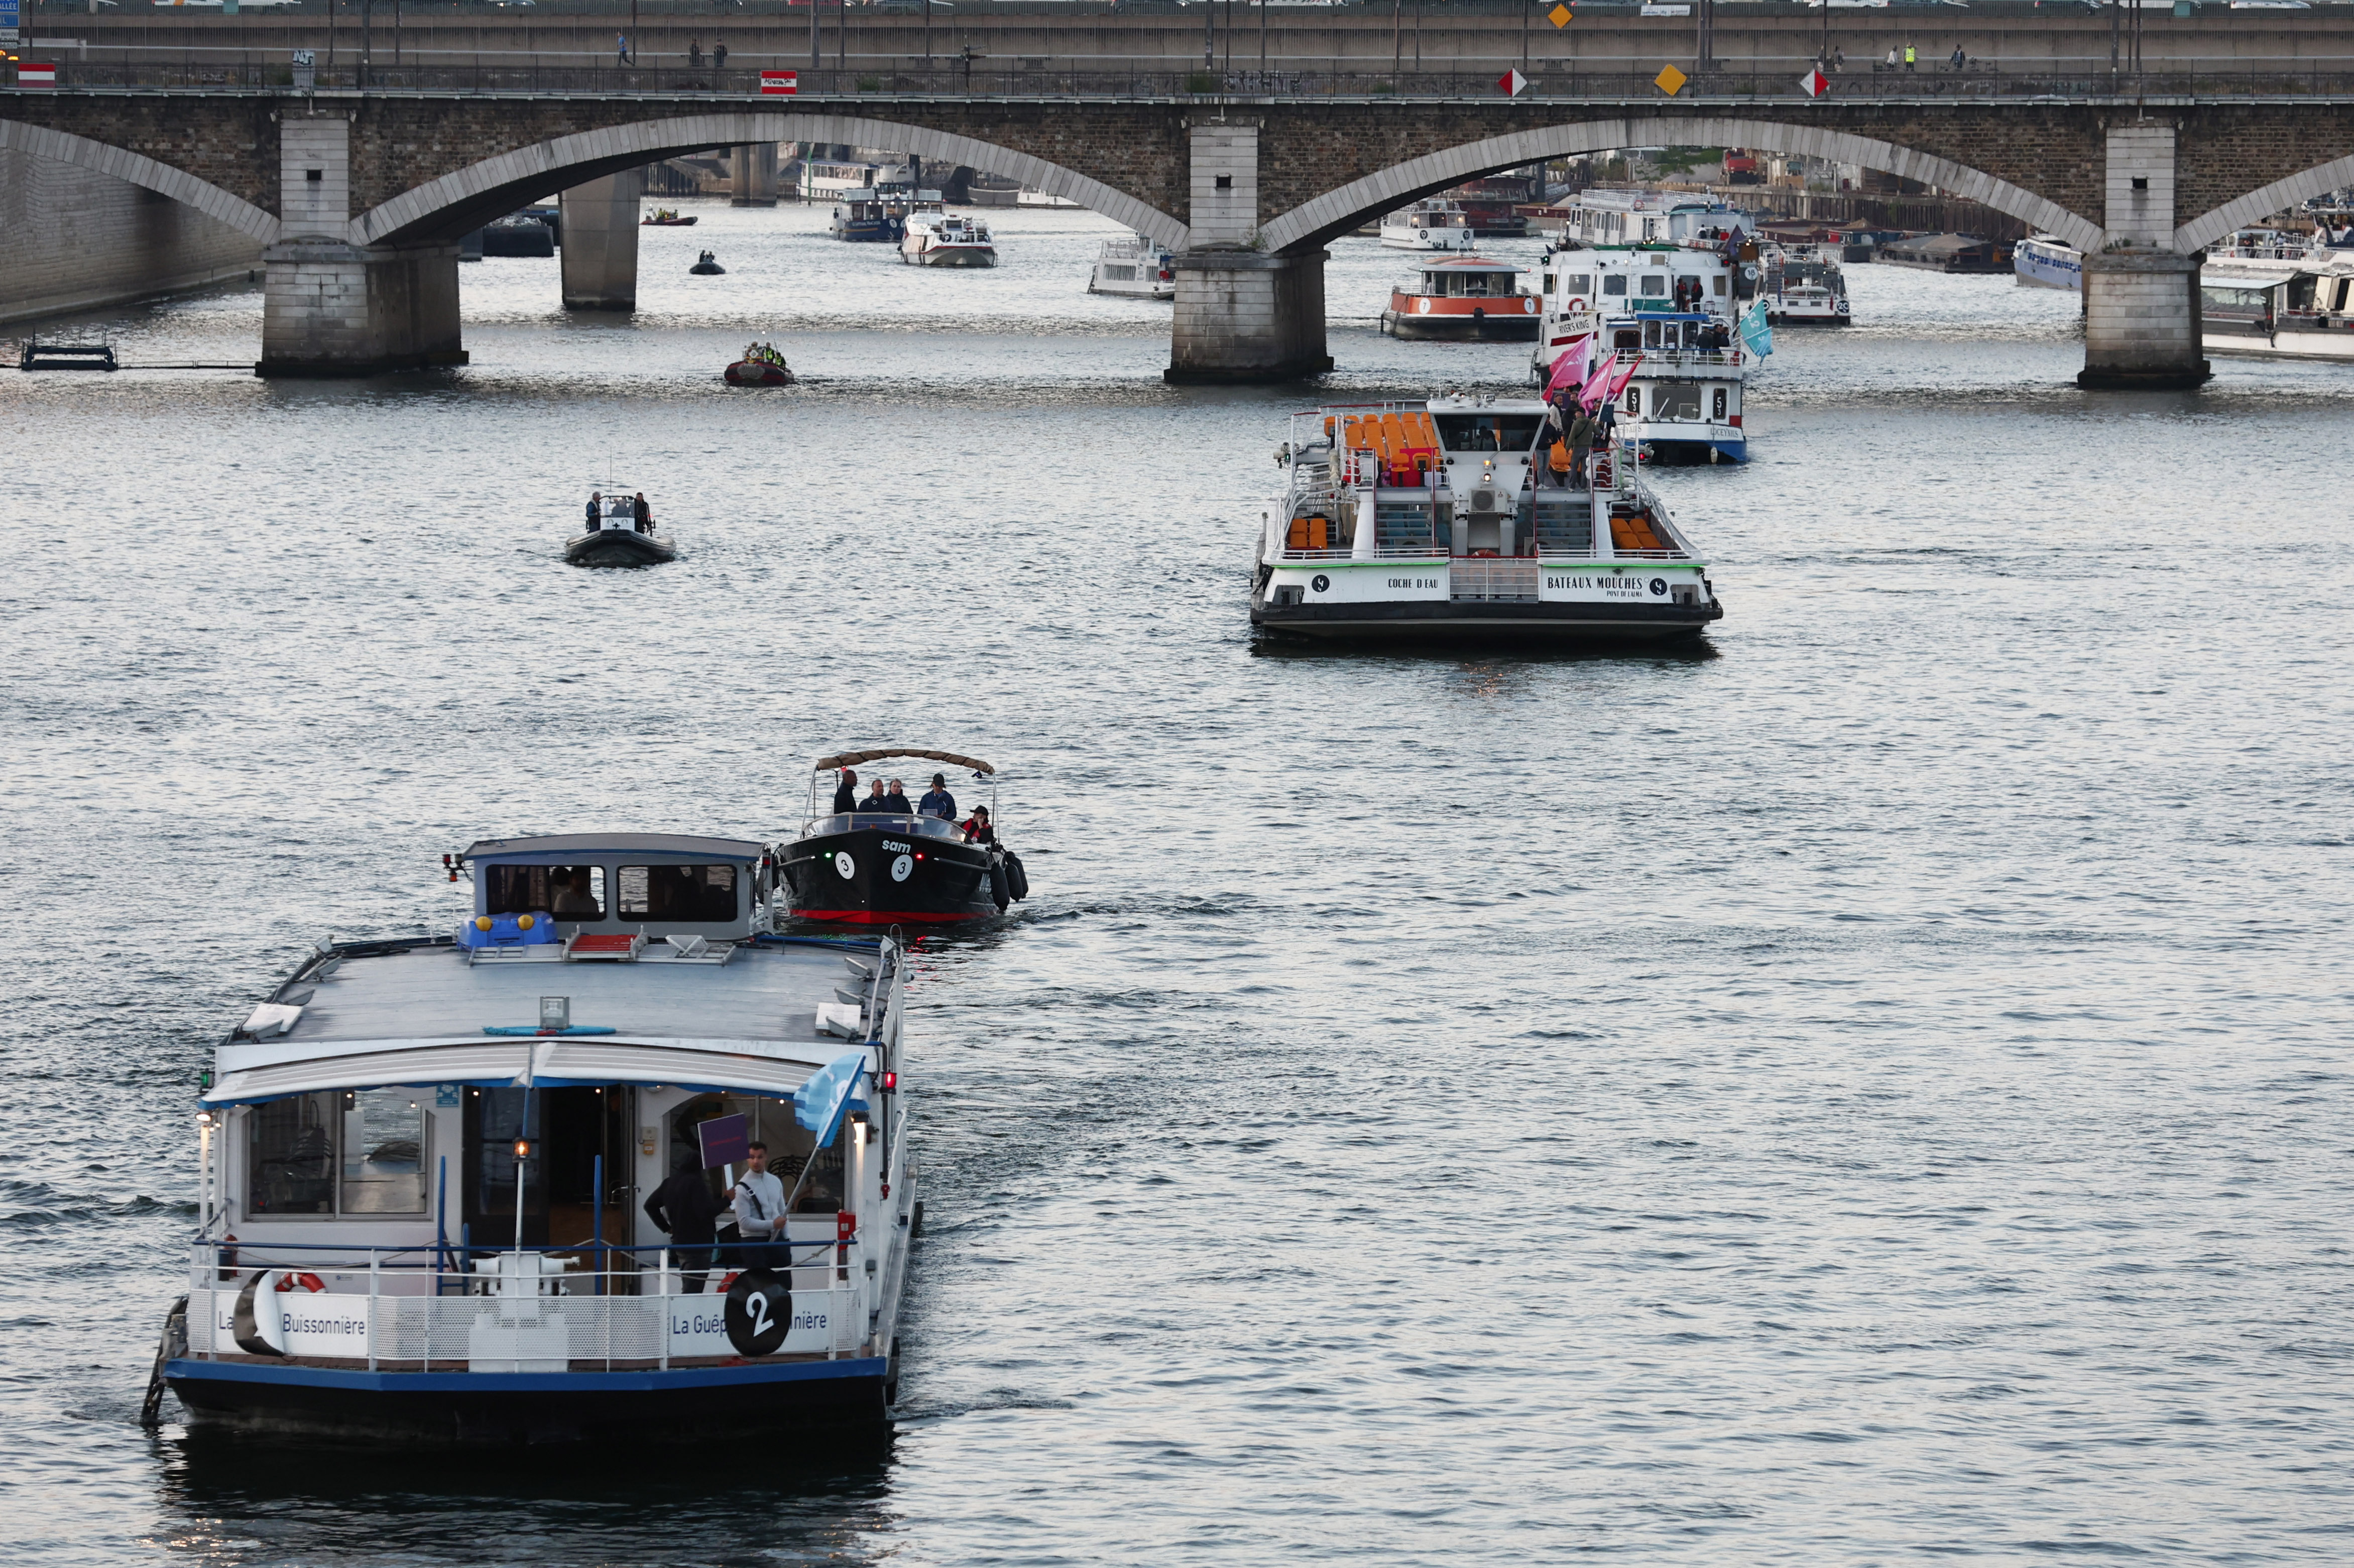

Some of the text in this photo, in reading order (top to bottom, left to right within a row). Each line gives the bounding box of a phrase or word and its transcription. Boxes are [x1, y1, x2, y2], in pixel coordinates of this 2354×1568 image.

[1559, 319, 1590, 334] RIVER'S KING
[1632, 393, 1637, 404] 5
[1717, 397, 1722, 408] 5
[1318, 578, 1324, 587] 4
[1388, 578, 1438, 588] COCHE D EAU
[1548, 577, 1642, 589] BATEAUX MOUCHES
[882, 839, 911, 854] sam
[841, 860, 849, 872] 3
[898, 862, 906, 874] 3
[746, 1291, 775, 1337] 2
[219, 1311, 365, 1335] La Buissonnière
[673, 1315, 688, 1335] La
[694, 1314, 727, 1338] Guêp
